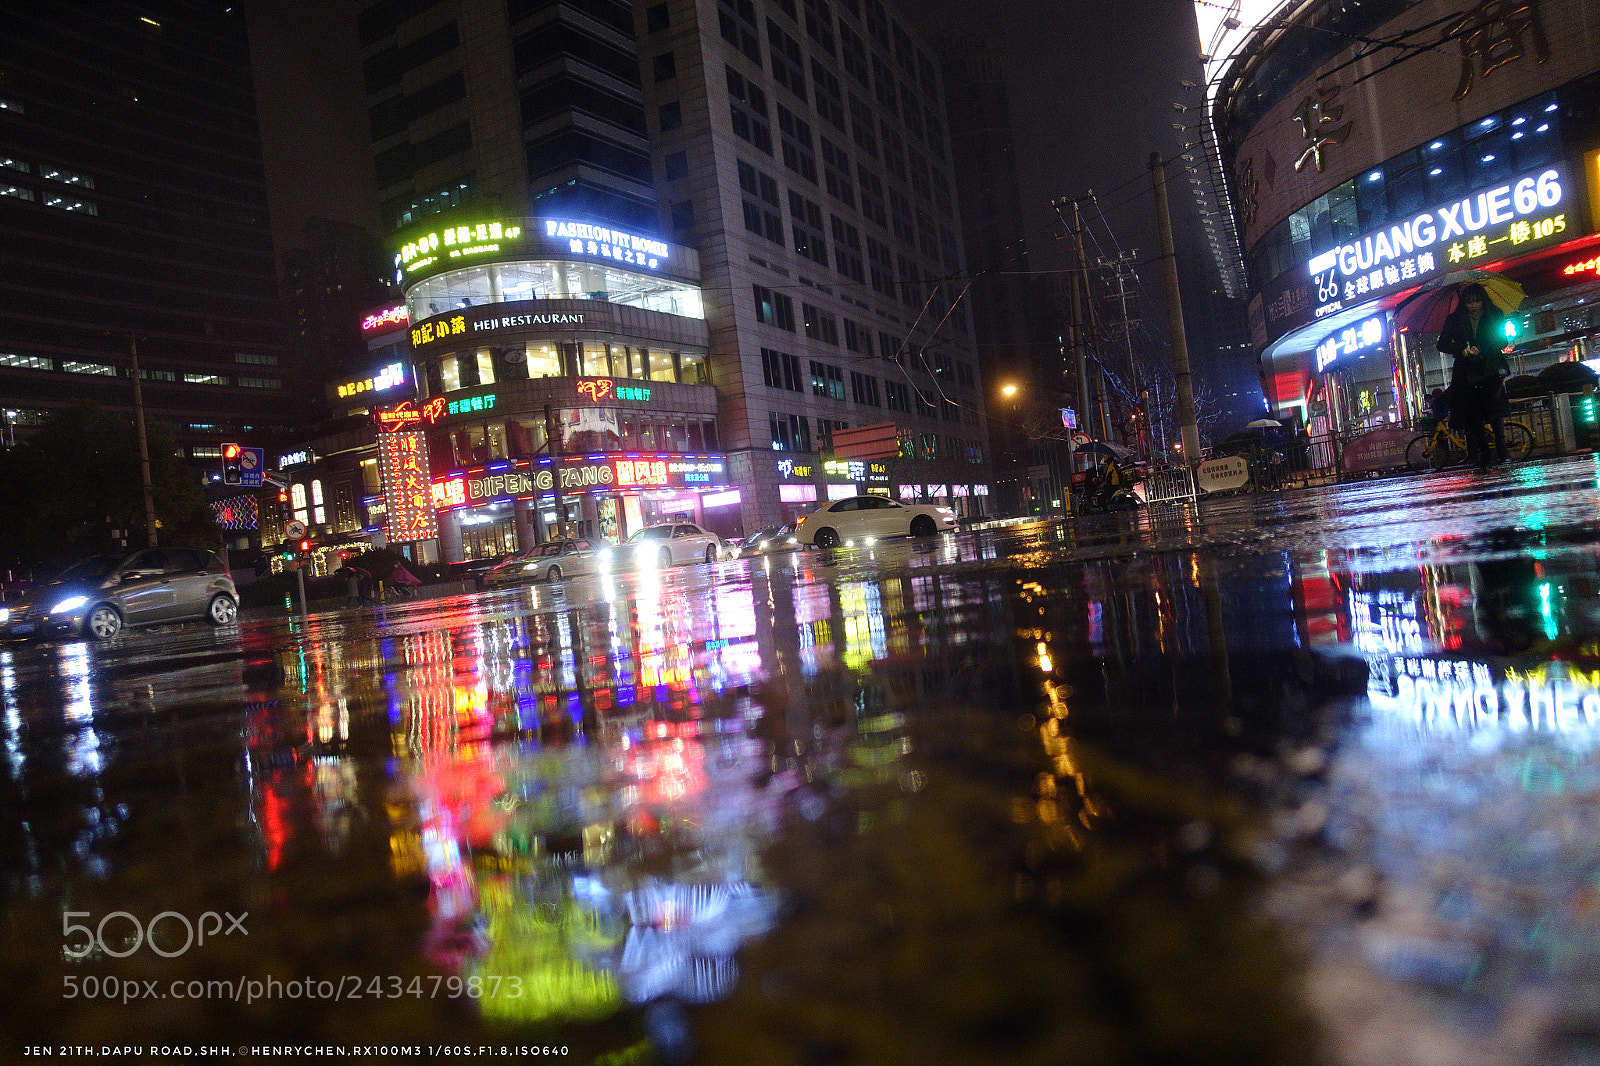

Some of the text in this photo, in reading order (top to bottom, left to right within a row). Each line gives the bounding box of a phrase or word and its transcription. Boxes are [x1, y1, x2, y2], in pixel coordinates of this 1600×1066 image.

[545, 220, 669, 258] FASHION FIT HOME
[1344, 251, 1435, 301] 全球眼镜连锁
[1315, 301, 1343, 317] OPTICAL
[473, 313, 585, 331] HEJI RESTAURANT
[448, 394, 496, 415] 新疆餐厅
[616, 386, 651, 402] 新疆餐厅
[389, 436, 408, 530] SHUNFENG RESTAURANT
[468, 470, 554, 499] BIFENG
[615, 460, 668, 485] 避风塘
